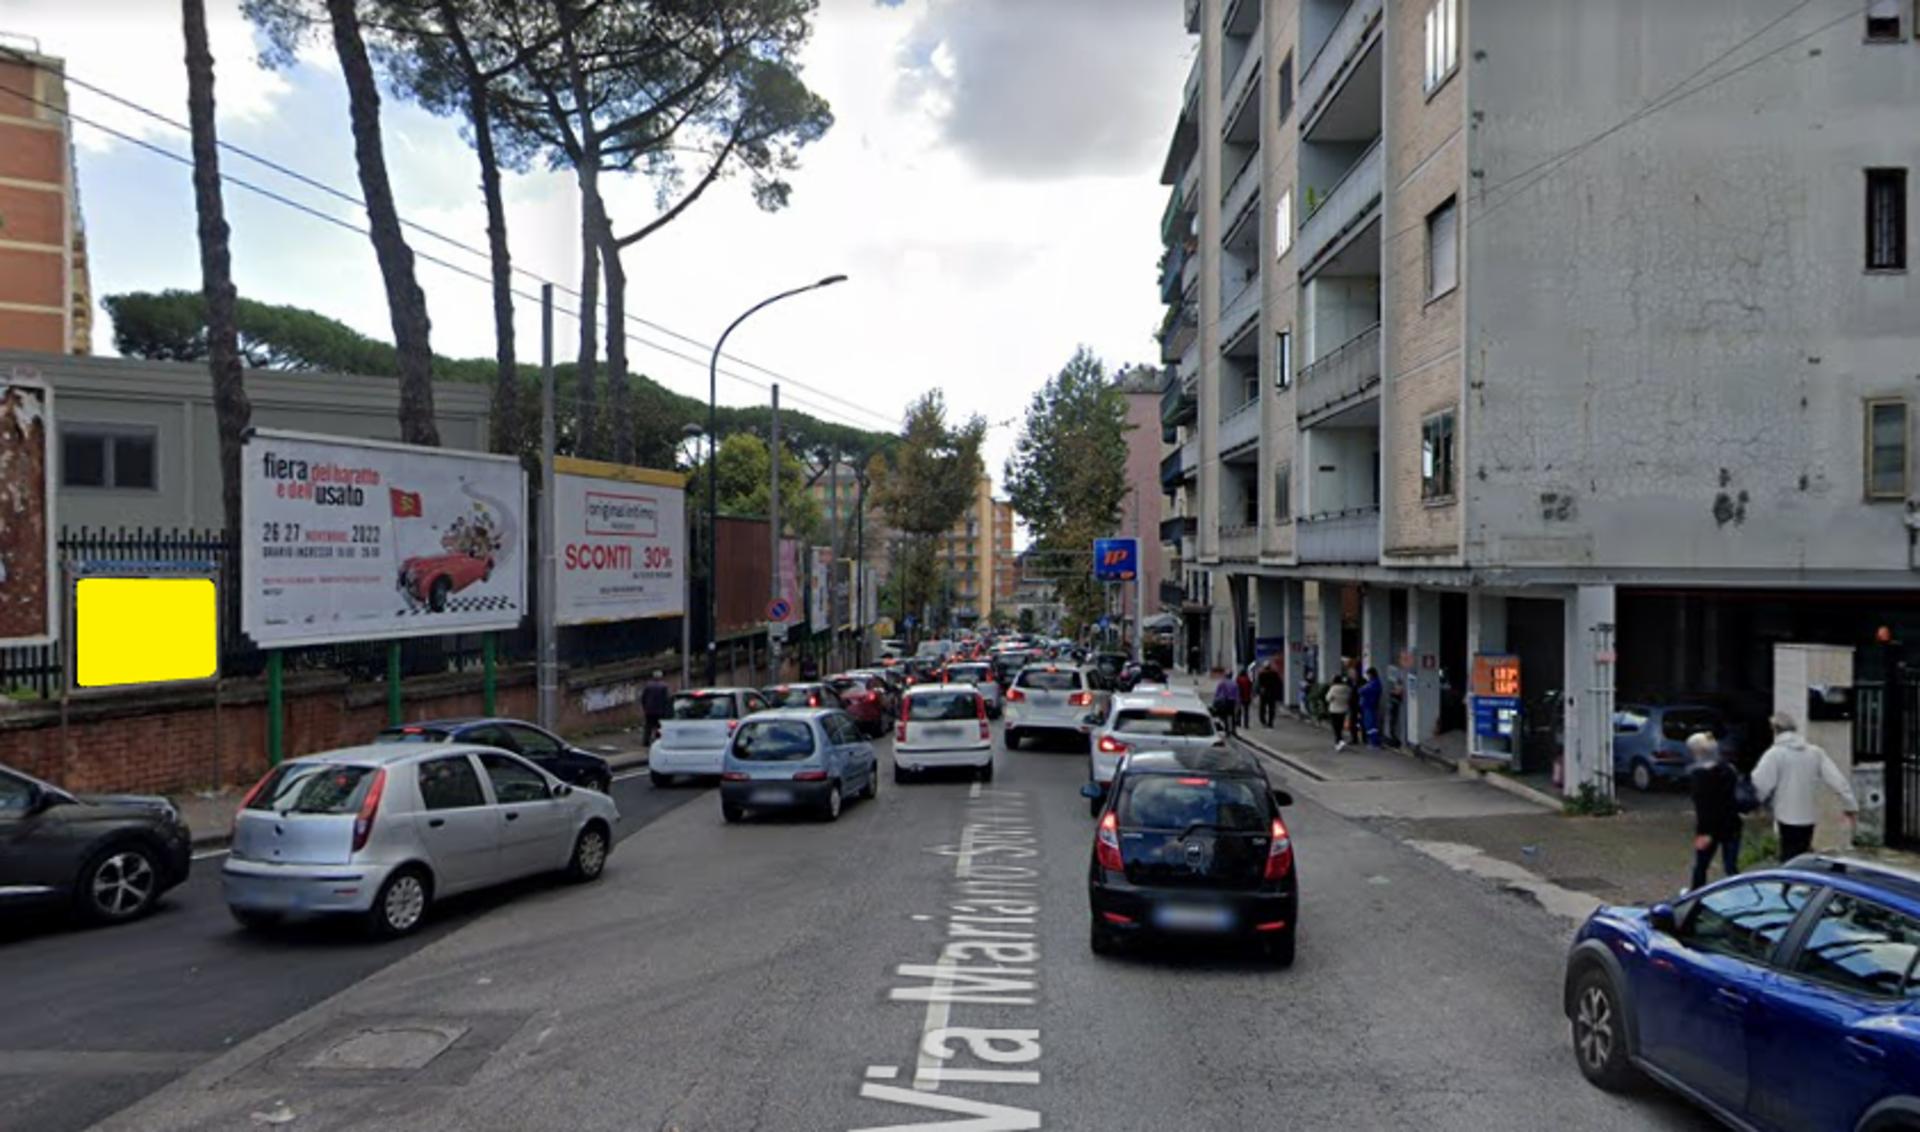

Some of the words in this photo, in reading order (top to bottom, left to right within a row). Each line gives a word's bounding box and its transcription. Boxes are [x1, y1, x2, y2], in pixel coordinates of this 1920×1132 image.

[263, 452, 308, 480] fiera
[263, 522, 279, 543] 26
[285, 523, 300, 543] 27
[352, 524, 380, 544] 2022
[565, 543, 632, 571] SCONTI
[643, 545, 673, 569] 30%
[889, 865, 1041, 1004] Mariano
[846, 1026, 1042, 1132] Via
